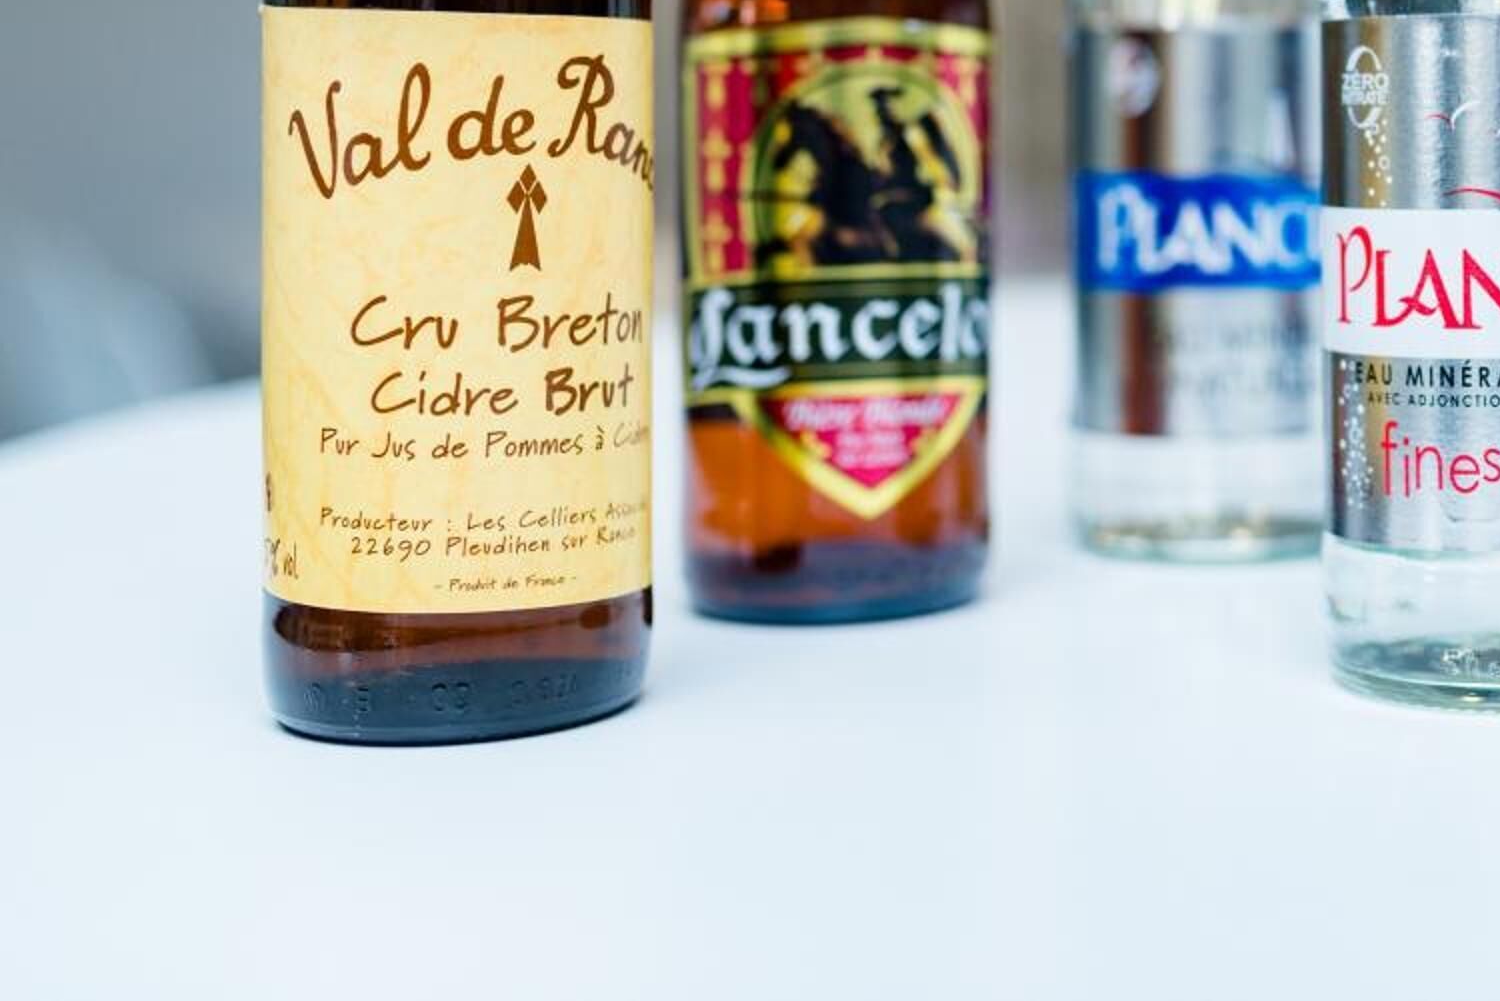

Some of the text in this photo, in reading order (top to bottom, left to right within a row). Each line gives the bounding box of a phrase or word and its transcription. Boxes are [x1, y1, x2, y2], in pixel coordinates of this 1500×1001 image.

[288, 62, 431, 199] Val
[446, 74, 537, 161] de
[350, 291, 643, 352] Cru Breton
[370, 362, 634, 416] Cidre Brut
[1355, 361, 1393, 386] EAU
[1367, 391, 1400, 407] AVEC
[320, 427, 359, 456] Pur
[371, 435, 416, 460] Jus
[432, 432, 468, 458] de
[485, 431, 583, 460] Pommes
[320, 506, 432, 532] Producteur
[466, 510, 505, 531] Les
[518, 506, 596, 529] Celliers
[351, 536, 431, 563] 22690
[562, 533, 585, 550] sur
